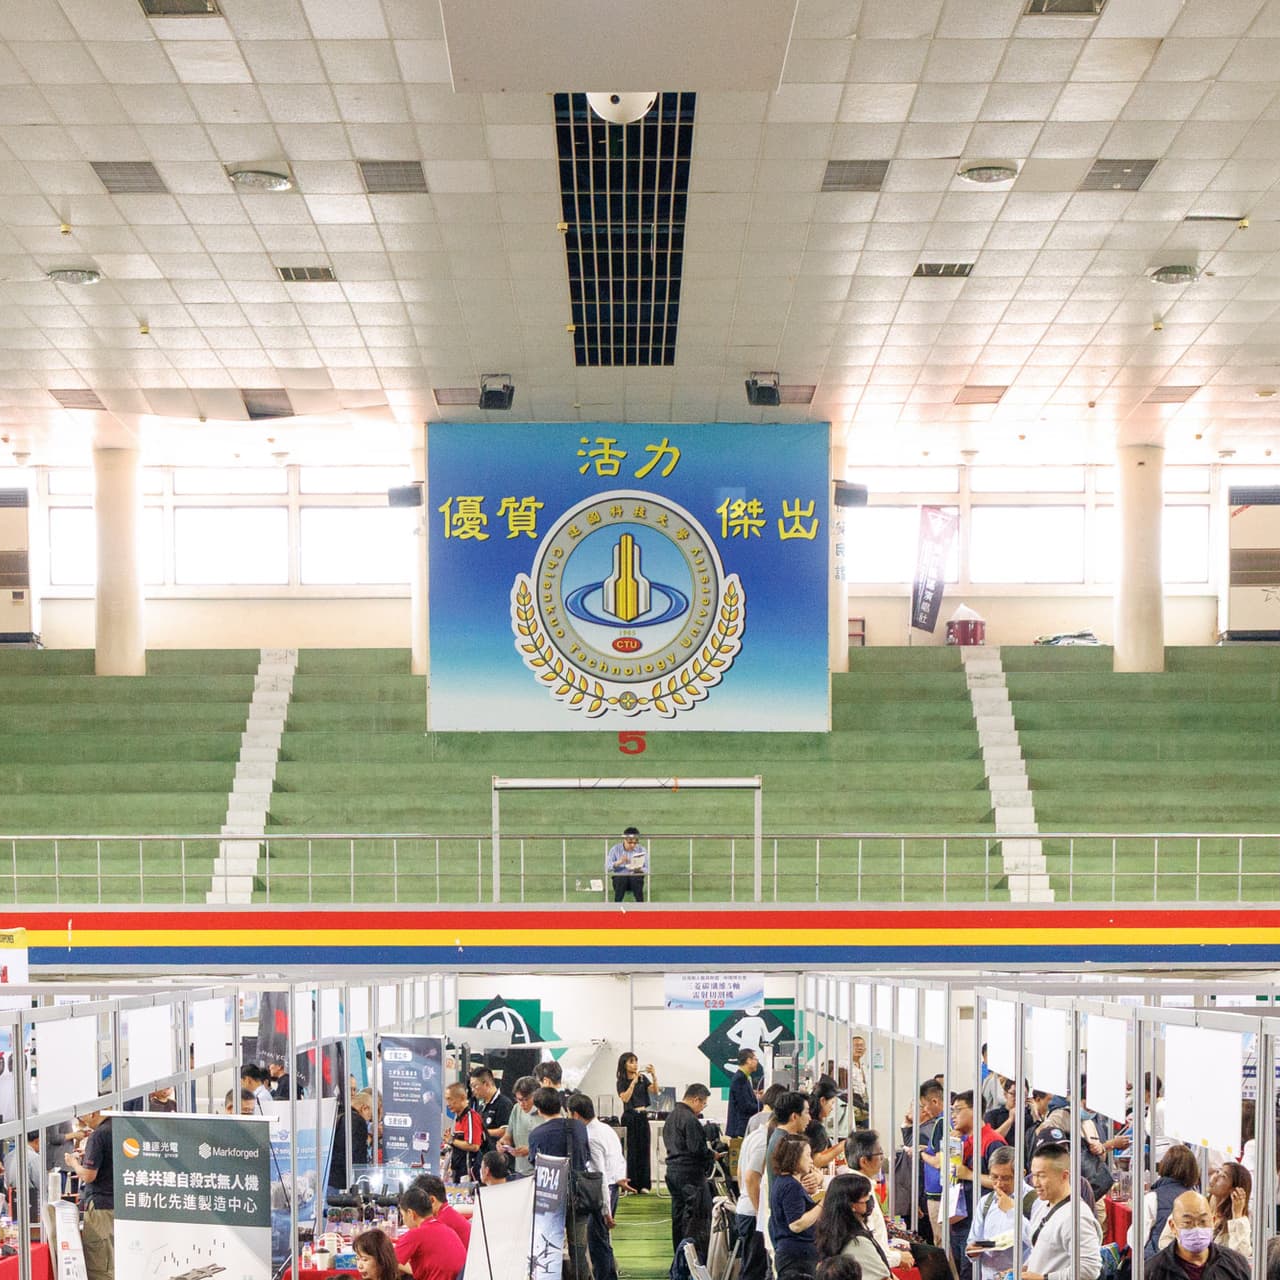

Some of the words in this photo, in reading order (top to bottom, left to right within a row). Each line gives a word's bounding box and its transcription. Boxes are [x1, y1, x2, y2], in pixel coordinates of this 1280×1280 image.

[577, 436, 681, 479] 活力
[438, 495, 544, 541] 優質
[568, 505, 690, 541] 建國科技大學
[715, 497, 820, 541] 傑出
[570, 643, 677, 677] Technology
[681, 545, 711, 649] University
[616, 638, 638, 650] CTU
[619, 731, 646, 754] 5
[704, 1000, 726, 1009] C29
[213, 1146, 259, 1160] Markforged
[122, 1169, 260, 1192] 台美共建自殺式無人機
[124, 1191, 258, 1214] 自動化先進製造中心
